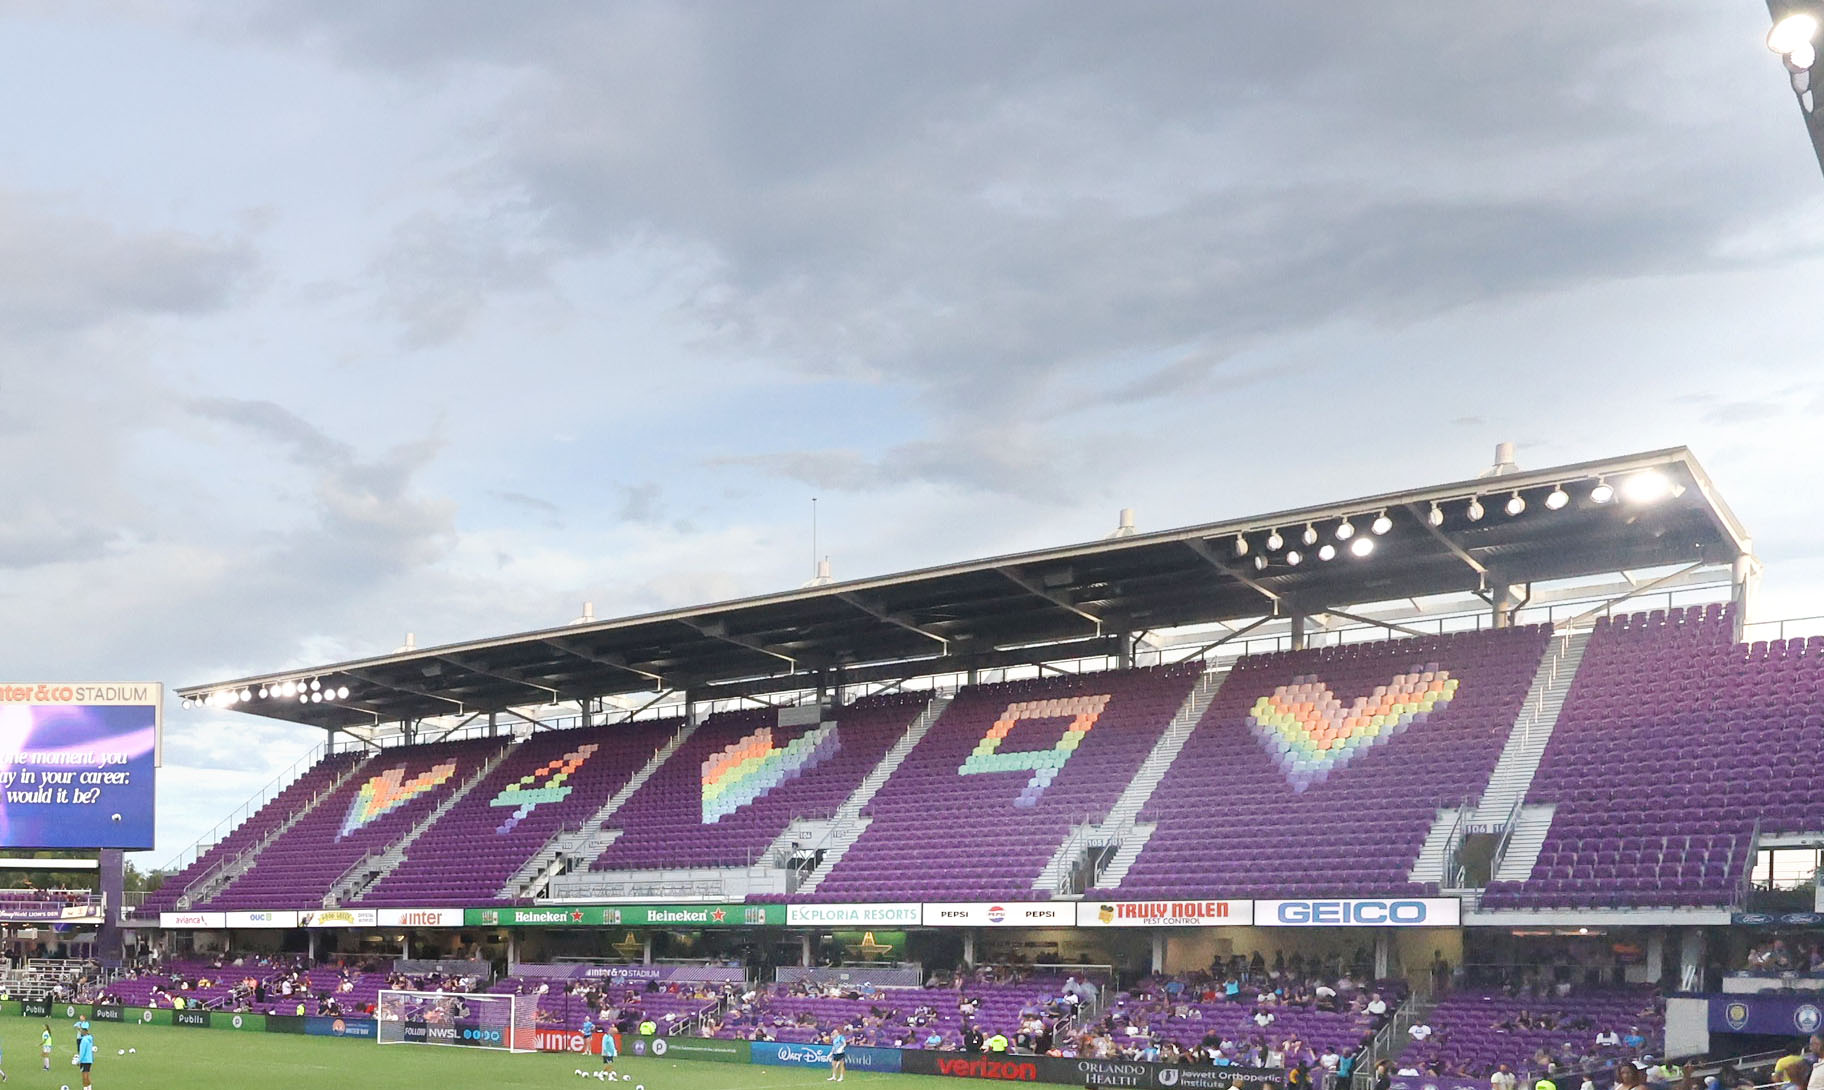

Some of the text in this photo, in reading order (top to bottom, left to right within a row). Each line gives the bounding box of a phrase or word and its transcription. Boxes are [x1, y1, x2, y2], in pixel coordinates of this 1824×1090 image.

[76, 687, 148, 701] STADIUM
[0, 751, 27, 765] one
[30, 750, 95, 765] moment
[98, 751, 128, 768] you
[20, 769, 36, 785] in
[39, 771, 77, 788] your
[79, 771, 130, 785] career.
[6, 787, 53, 804] would
[55, 788, 69, 804] it
[72, 787, 101, 804] be?
[515, 911, 567, 922] Heineken
[647, 910, 707, 921] Heineken
[791, 908, 918, 921] EXPLORIA RESORTS
[940, 910, 969, 919] PEPSI
[1025, 910, 1056, 919] PEPSI
[1116, 902, 1229, 919] TRULY NOLEN
[1277, 901, 1426, 924] GEICO
[175, 915, 201, 925] avianca
[249, 913, 265, 921] OUC
[408, 911, 442, 925] inter
[628, 970, 660, 978] STADIUM
[97, 1009, 118, 1019] Publix
[178, 1014, 204, 1024] Publix
[428, 1028, 461, 1039] NWSL
[546, 1034, 585, 1052] inte
[937, 1056, 1037, 1081] verizon
[1078, 1061, 1146, 1076] ORLANDO
[1085, 1073, 1137, 1086] HEALTH
[1181, 1070, 1215, 1080] Jewett
[1180, 1078, 1225, 1088] Institute
